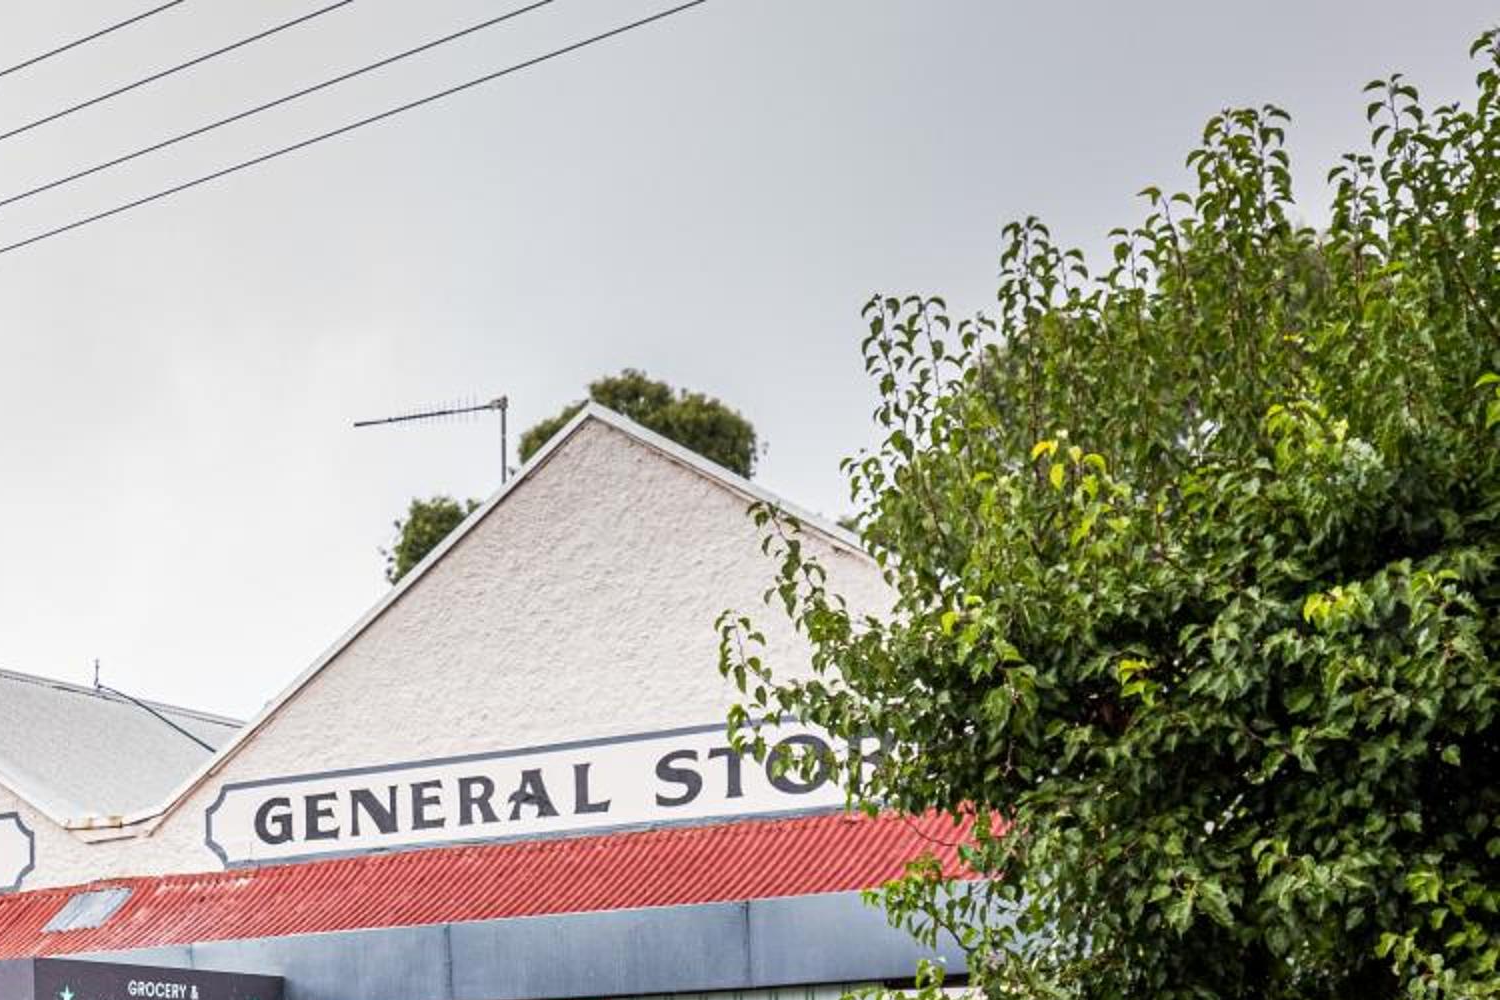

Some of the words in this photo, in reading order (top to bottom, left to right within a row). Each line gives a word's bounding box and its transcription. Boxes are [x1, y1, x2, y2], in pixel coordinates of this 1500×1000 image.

[255, 763, 610, 845] GENERAL
[655, 730, 898, 807] STOR
[127, 979, 187, 999] GROCERY
[190, 985, 199, 1000] &
